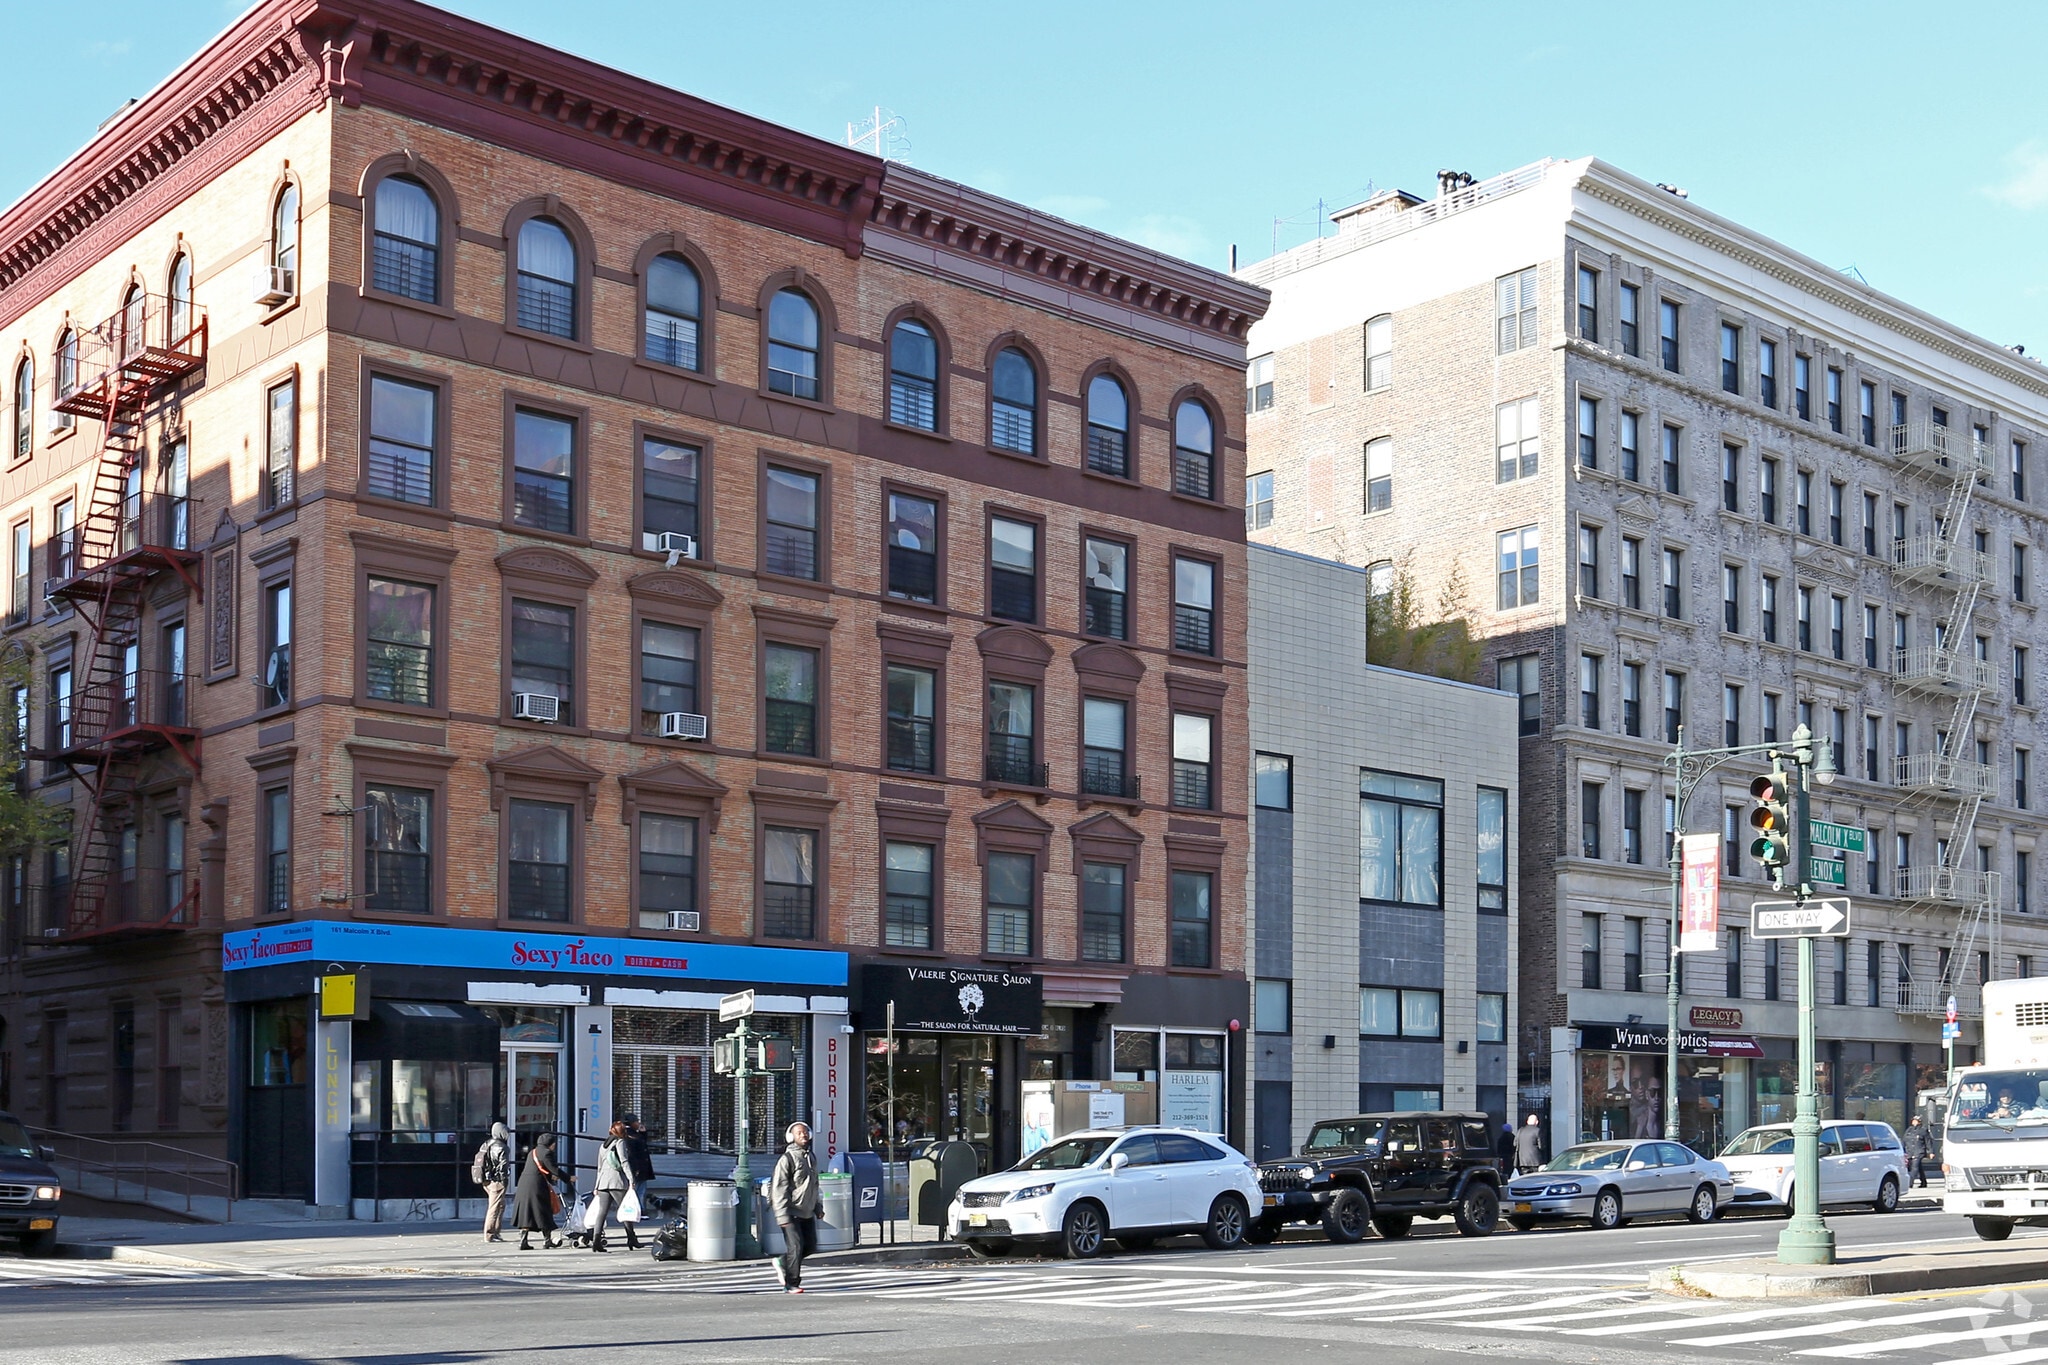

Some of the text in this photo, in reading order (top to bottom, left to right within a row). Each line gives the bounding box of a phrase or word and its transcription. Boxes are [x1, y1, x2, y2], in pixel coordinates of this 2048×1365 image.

[1810, 822, 1863, 848] MALCOLM X BLVD
[1811, 860, 1844, 882] LENOX AV
[1764, 912, 1821, 927] ONE WAY
[331, 926, 342, 934] 161
[343, 927, 369, 935] Malcolm
[224, 932, 276, 966] Sexy Taco
[511, 939, 613, 969] Sexy Taco
[630, 958, 683, 969] DIRTY CASH
[908, 967, 1032, 987] VALERIE SIGNATURE SALON
[1693, 1009, 1732, 1020] LEGACY
[920, 1021, 1017, 1032] THE SALON FOR NATURAL HAIR
[1616, 1028, 1649, 1047] Wynn
[326, 1037, 339, 1125] LUNCH
[590, 1033, 600, 1118] TACOS
[1171, 1074, 1209, 1085] HARLEM
[828, 1038, 837, 1159] BURRITOS
